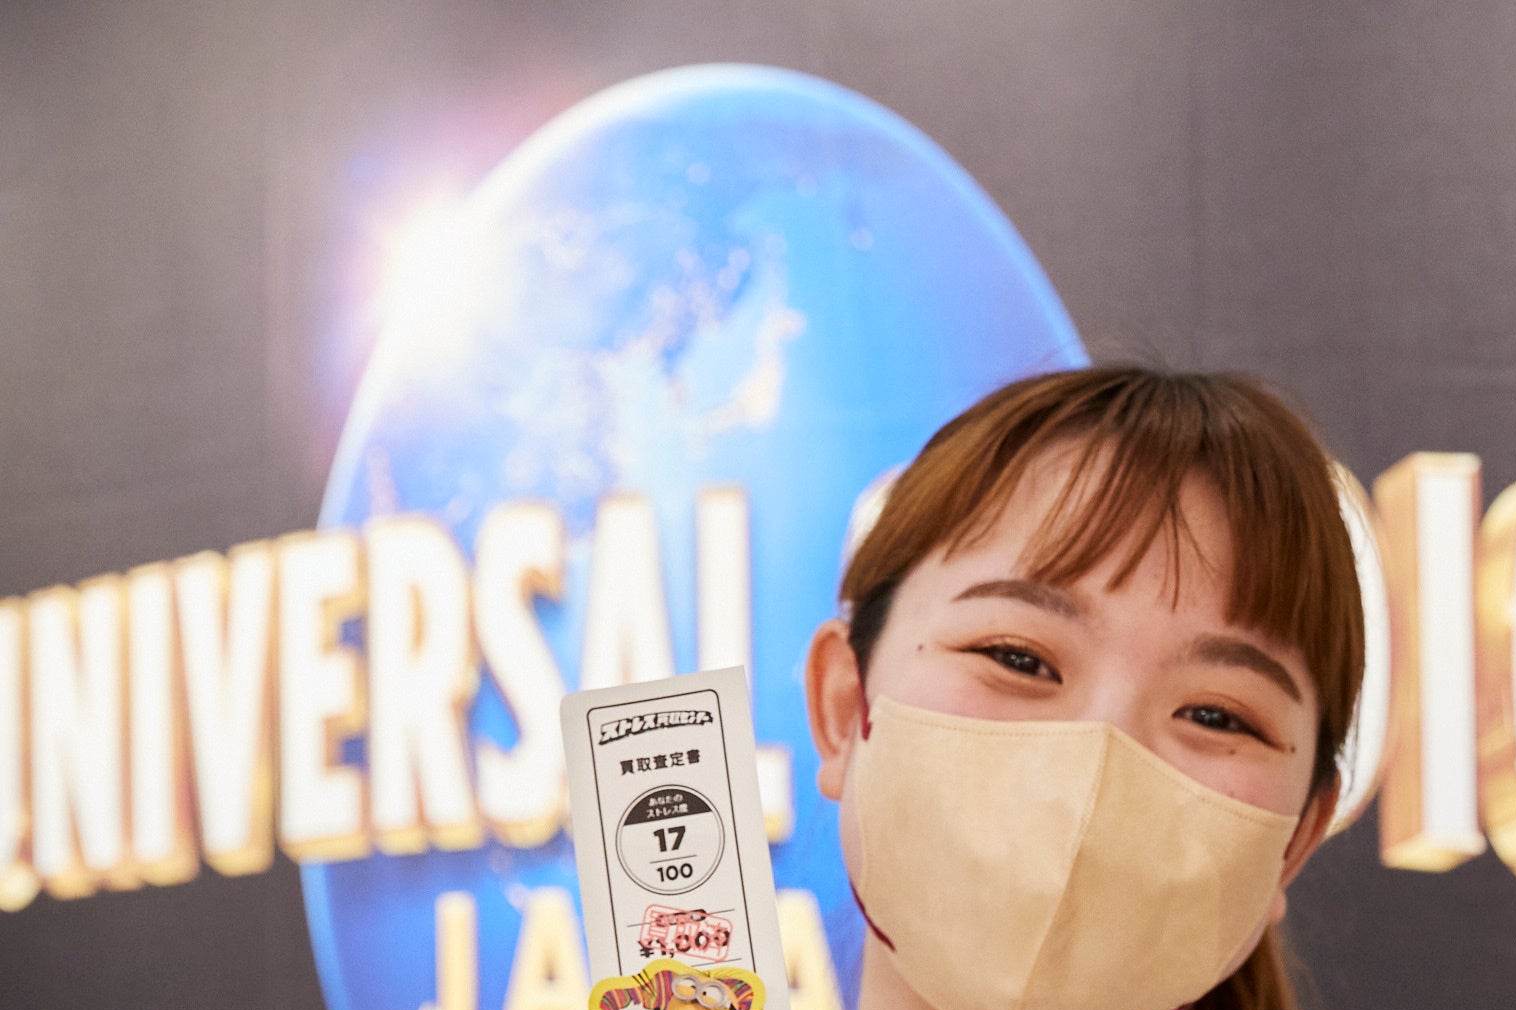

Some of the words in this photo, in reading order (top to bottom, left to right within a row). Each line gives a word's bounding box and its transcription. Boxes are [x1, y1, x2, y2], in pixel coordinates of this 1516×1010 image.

[620, 749, 701, 775] 買取査定書
[653, 825, 686, 852] 17
[656, 863, 693, 882] 100
